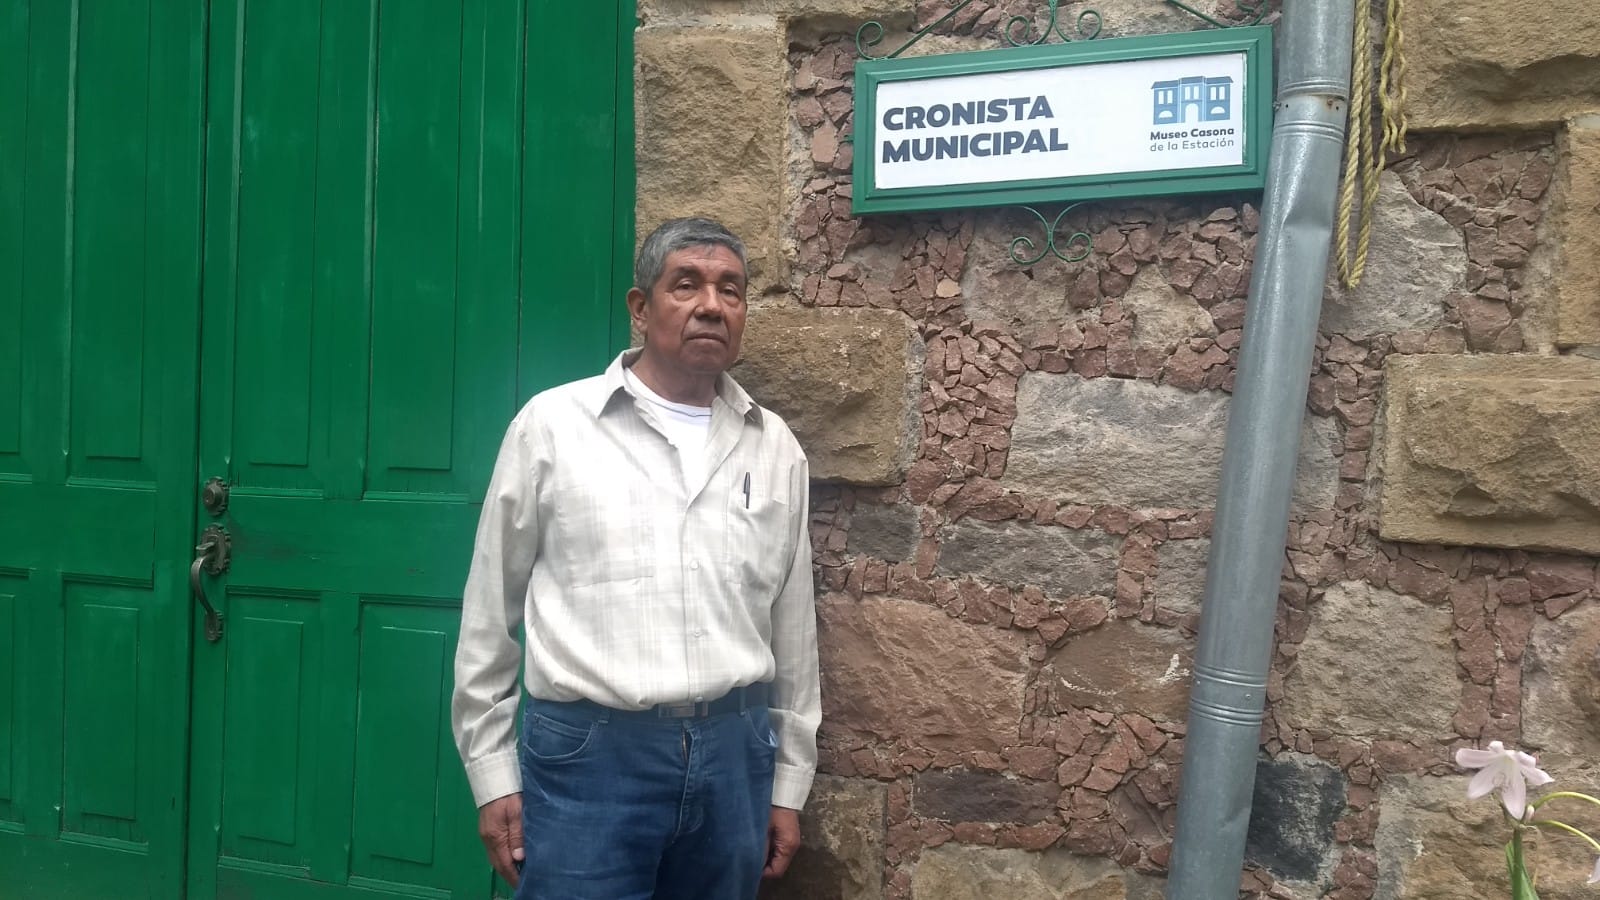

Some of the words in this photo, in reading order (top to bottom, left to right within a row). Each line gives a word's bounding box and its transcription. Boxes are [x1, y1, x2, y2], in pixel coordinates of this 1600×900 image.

[882, 95, 1054, 131] CRONISTA
[881, 127, 1069, 163] MUNICIPAL
[1150, 131, 1188, 141] Museo
[1190, 128, 1235, 138] Casona
[1150, 142, 1164, 152] de
[1167, 141, 1178, 151] la
[1182, 138, 1234, 150] Estación
